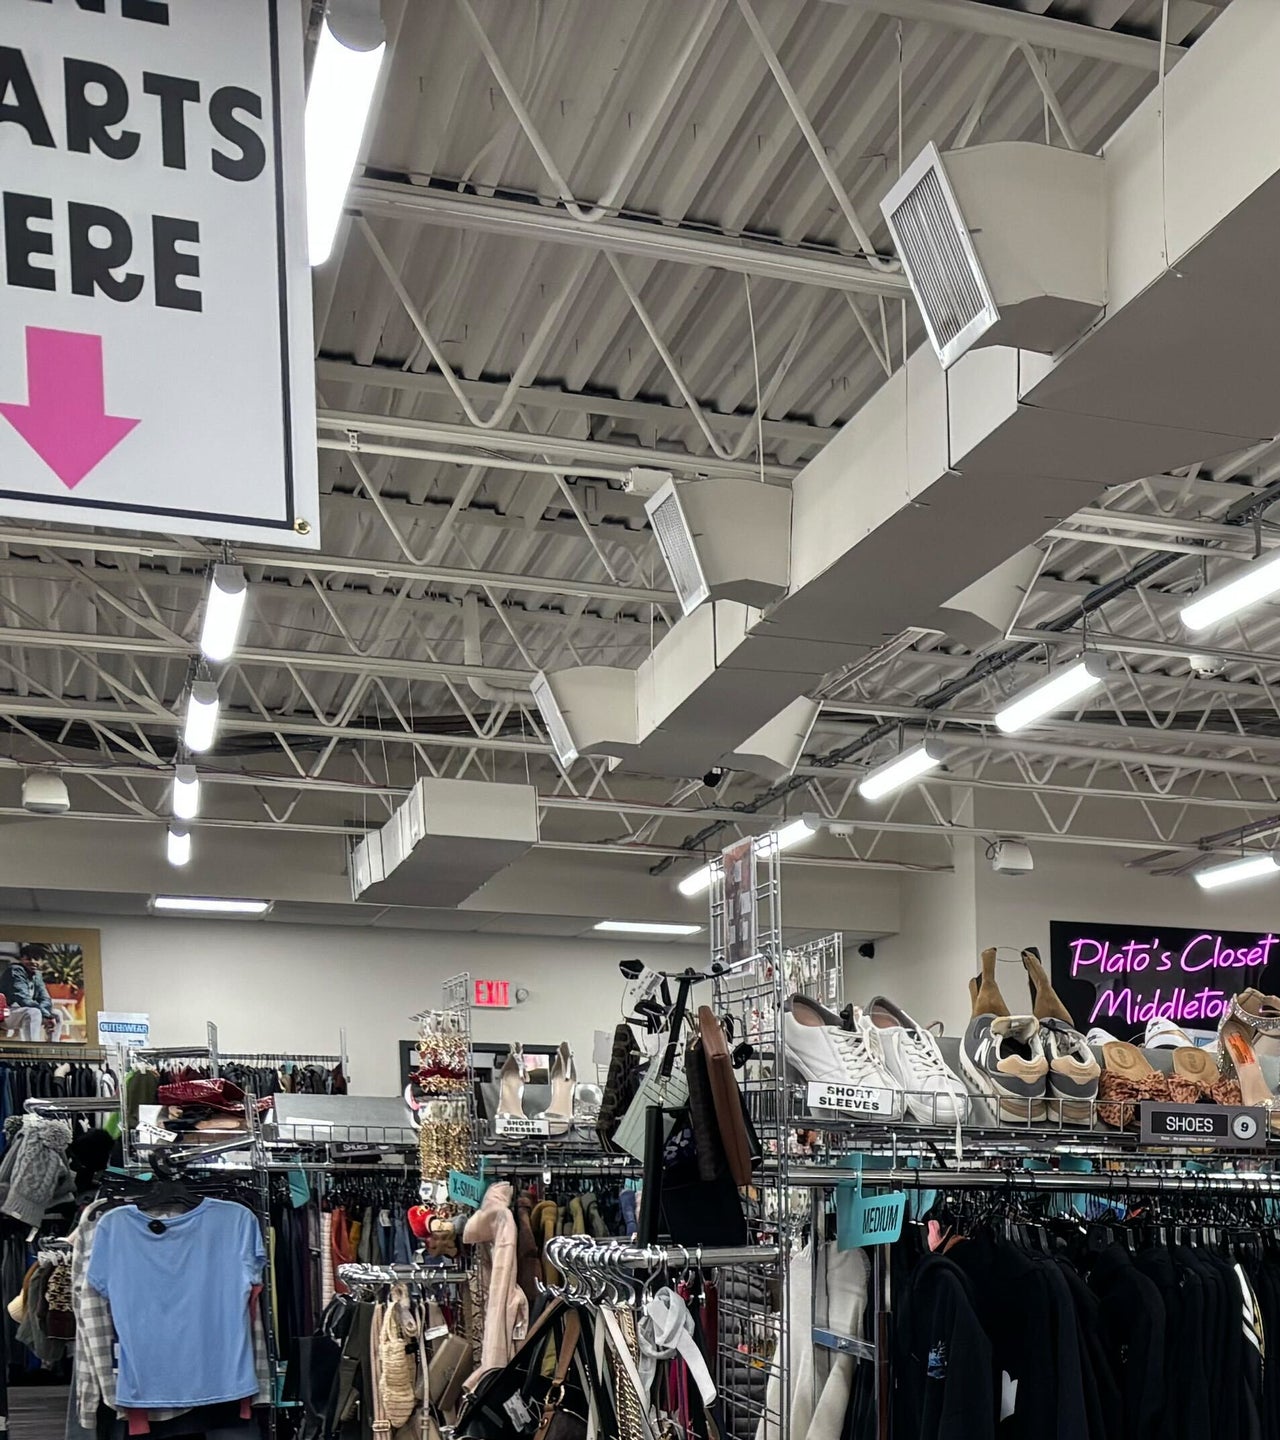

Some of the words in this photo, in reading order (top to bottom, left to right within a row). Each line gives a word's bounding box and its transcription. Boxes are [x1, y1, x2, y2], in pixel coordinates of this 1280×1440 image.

[1069, 937, 1172, 977] Plato's
[1181, 932, 1280, 972] Closet
[475, 979, 510, 1007] EXIT
[1089, 987, 1232, 1025] Middleto
[819, 1096, 880, 1111] SLEEVES
[827, 1086, 874, 1099] SHORT
[503, 1126, 542, 1134] DRESSES
[1166, 1116, 1214, 1133] SHOES
[1240, 1122, 1249, 1132] 9
[452, 1178, 480, 1202] X-SMALL
[862, 1204, 899, 1234] MEDIUM
